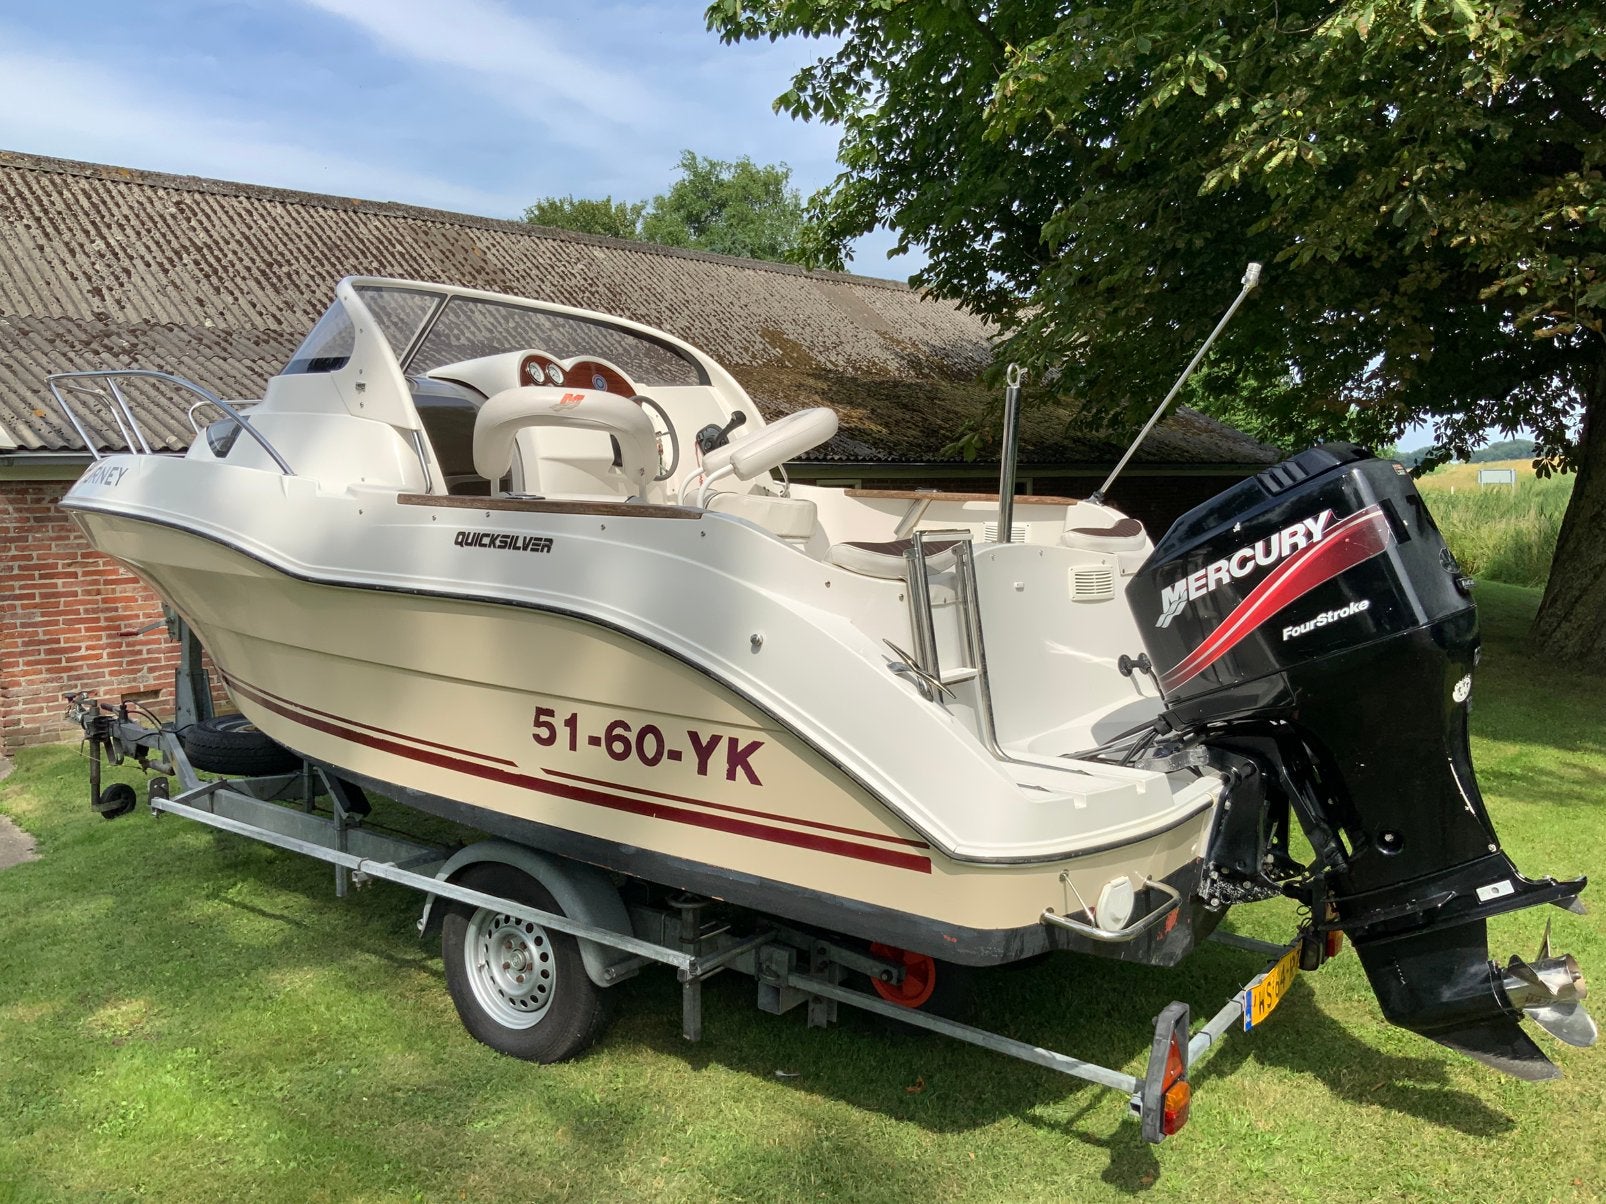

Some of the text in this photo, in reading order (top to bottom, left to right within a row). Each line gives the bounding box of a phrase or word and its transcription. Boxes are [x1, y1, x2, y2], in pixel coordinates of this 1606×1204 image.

[454, 531, 554, 553] QUICKSILVER
[1155, 508, 1334, 628] MERCURY
[1282, 599, 1370, 641] FourStroke
[532, 706, 766, 787] 51-60-YK
